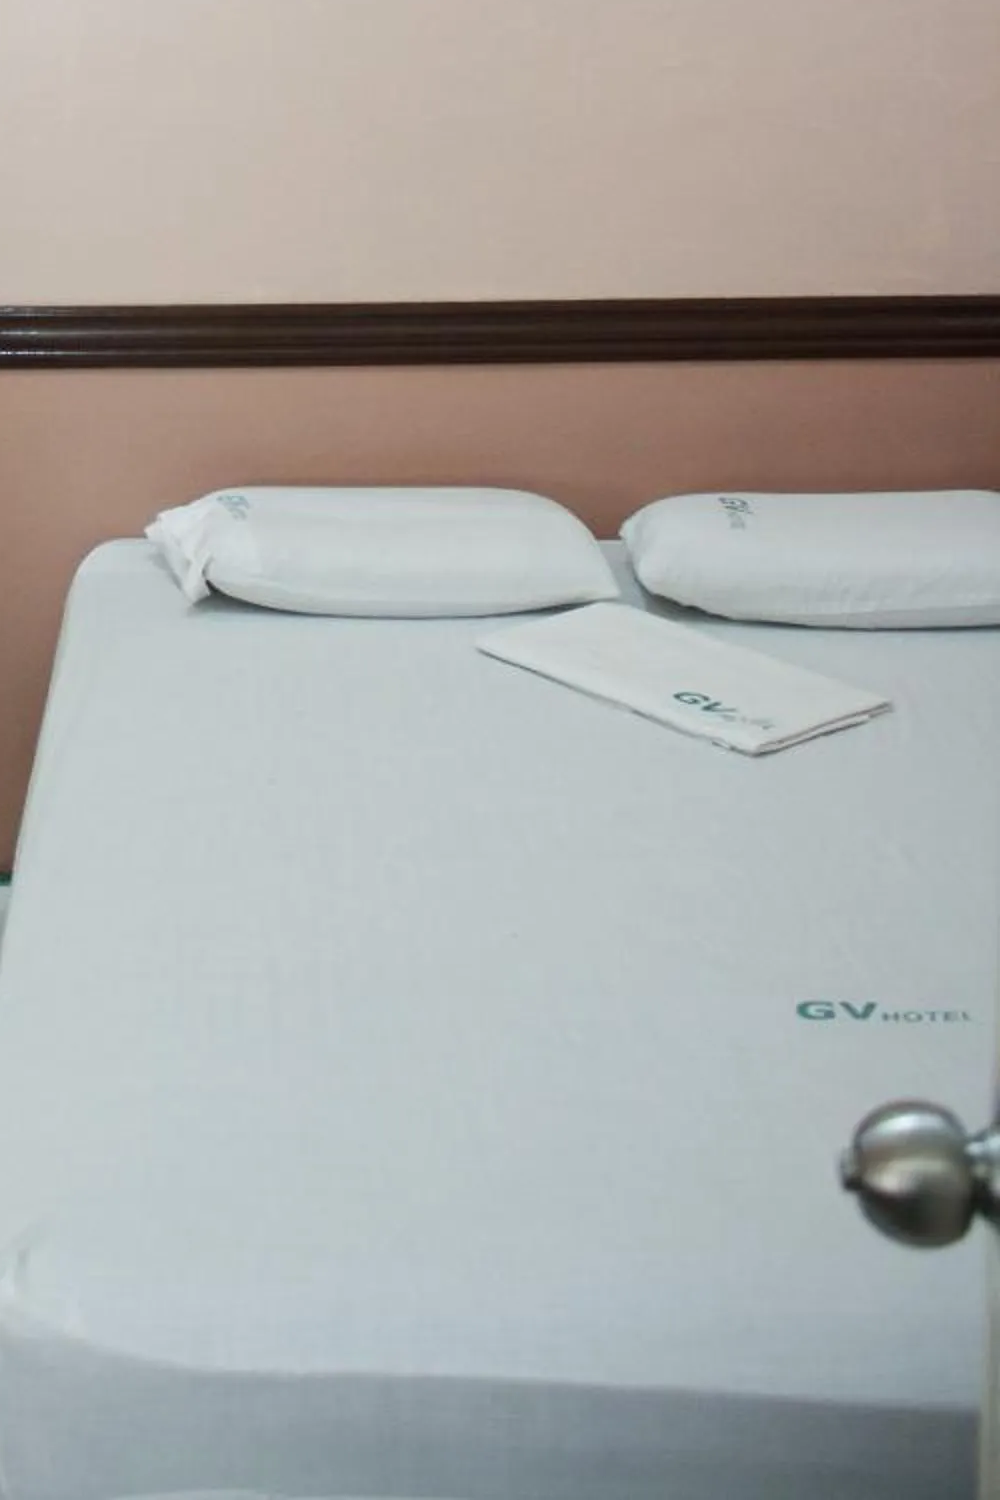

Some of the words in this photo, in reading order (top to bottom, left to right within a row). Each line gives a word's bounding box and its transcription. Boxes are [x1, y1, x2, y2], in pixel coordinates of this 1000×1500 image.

[672, 690, 738, 712] GV
[796, 1000, 878, 1021] GV
[881, 1009, 973, 1024] HOTEL
